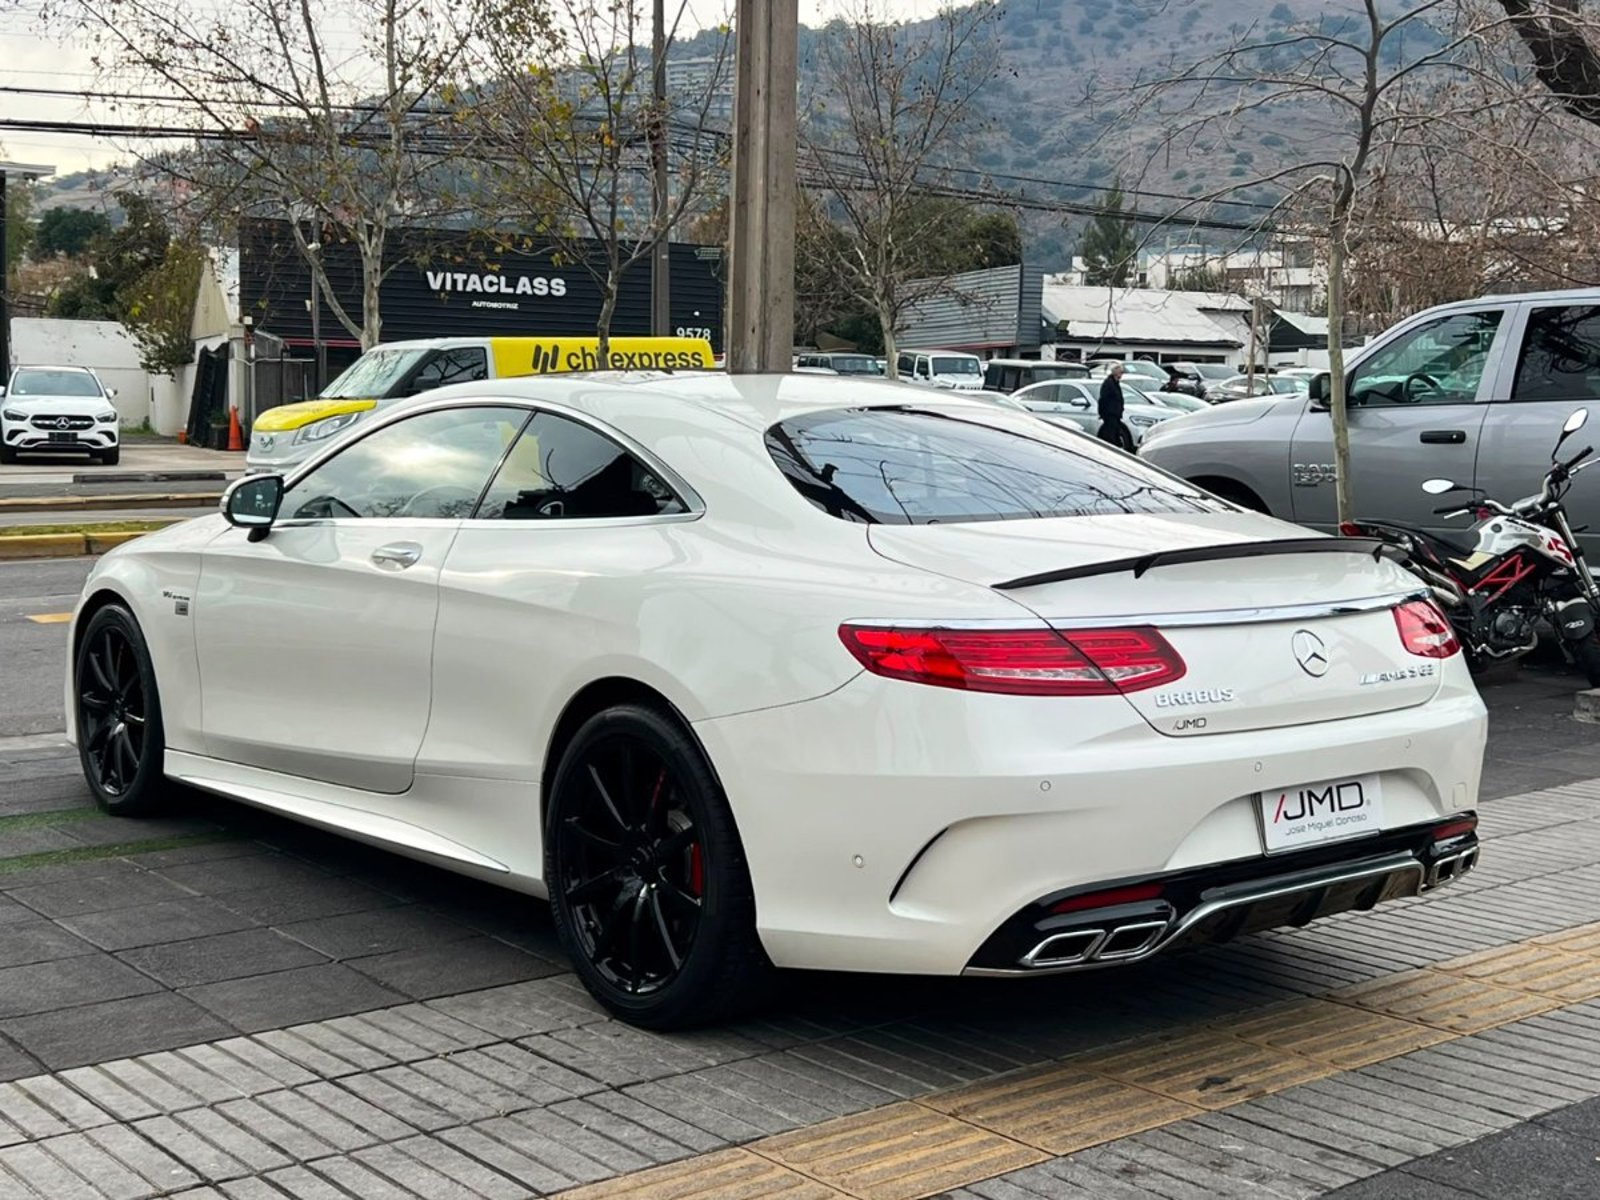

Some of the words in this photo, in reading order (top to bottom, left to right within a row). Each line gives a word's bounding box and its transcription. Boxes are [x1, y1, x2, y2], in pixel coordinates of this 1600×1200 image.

[426, 271, 567, 297] VITACLASS
[471, 300, 519, 310] AUTOMOTRIZ
[676, 327, 711, 342] 9578
[1155, 689, 1234, 707] BRABUS
[1307, 819, 1333, 831] Miguel
[1335, 814, 1367, 826] Donoso
